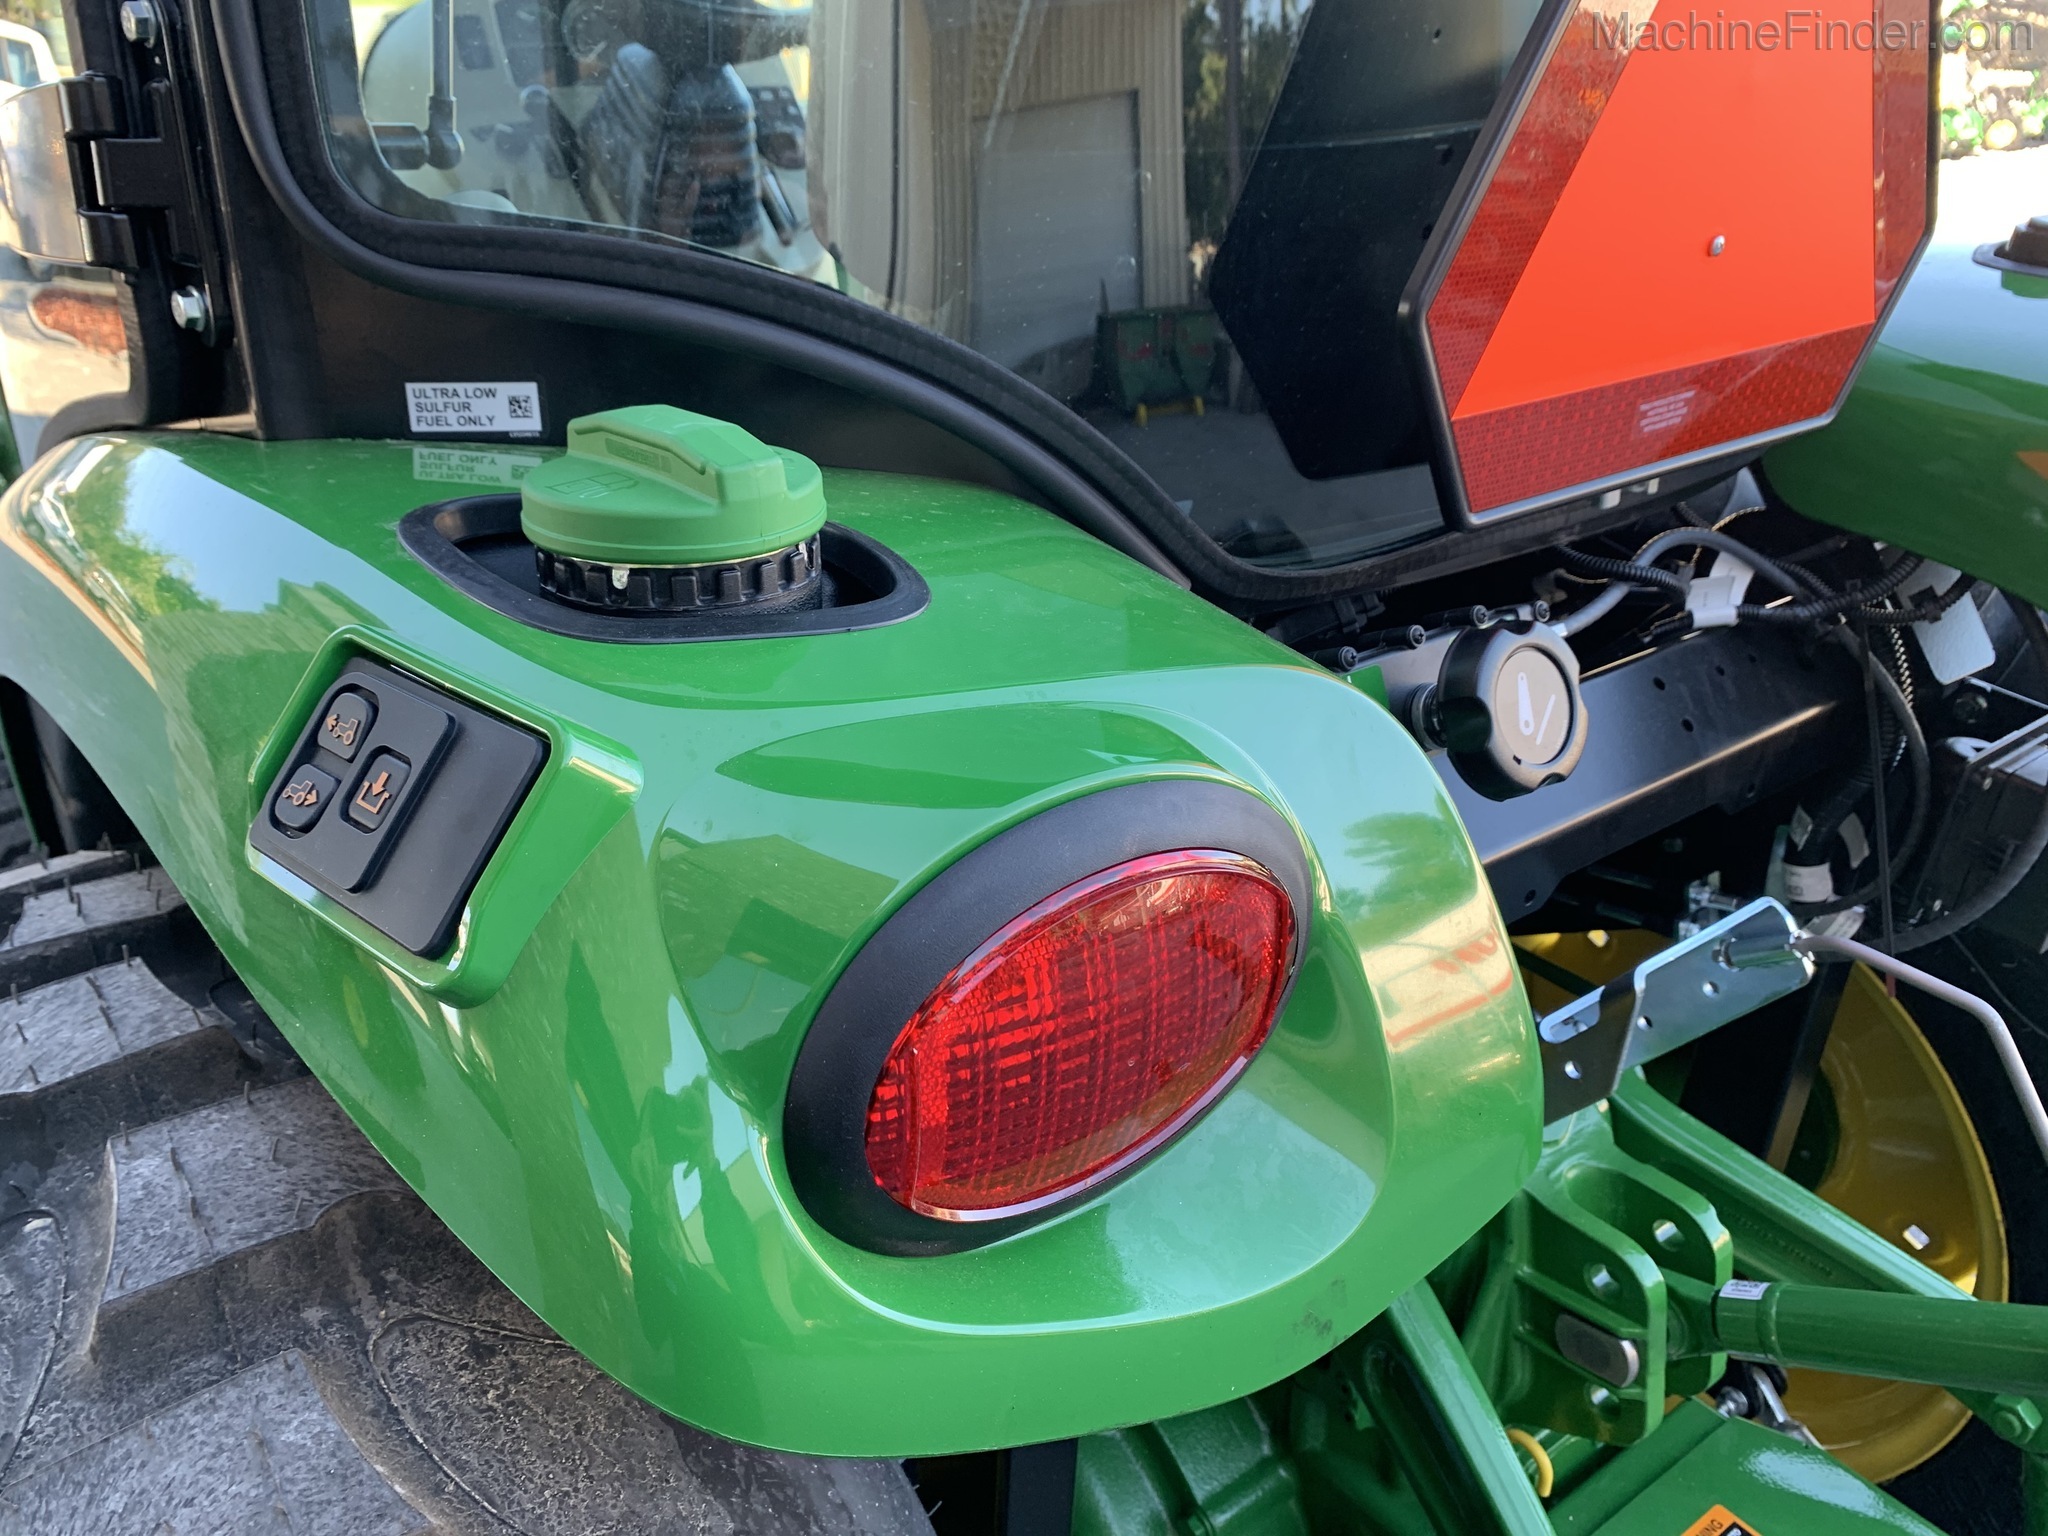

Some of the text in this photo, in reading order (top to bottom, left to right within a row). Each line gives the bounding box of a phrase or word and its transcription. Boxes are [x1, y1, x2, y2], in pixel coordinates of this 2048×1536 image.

[412, 387, 497, 399] ULTRA LOW
[415, 401, 472, 413] SULFUR
[416, 415, 495, 427] FUEL ONLY
